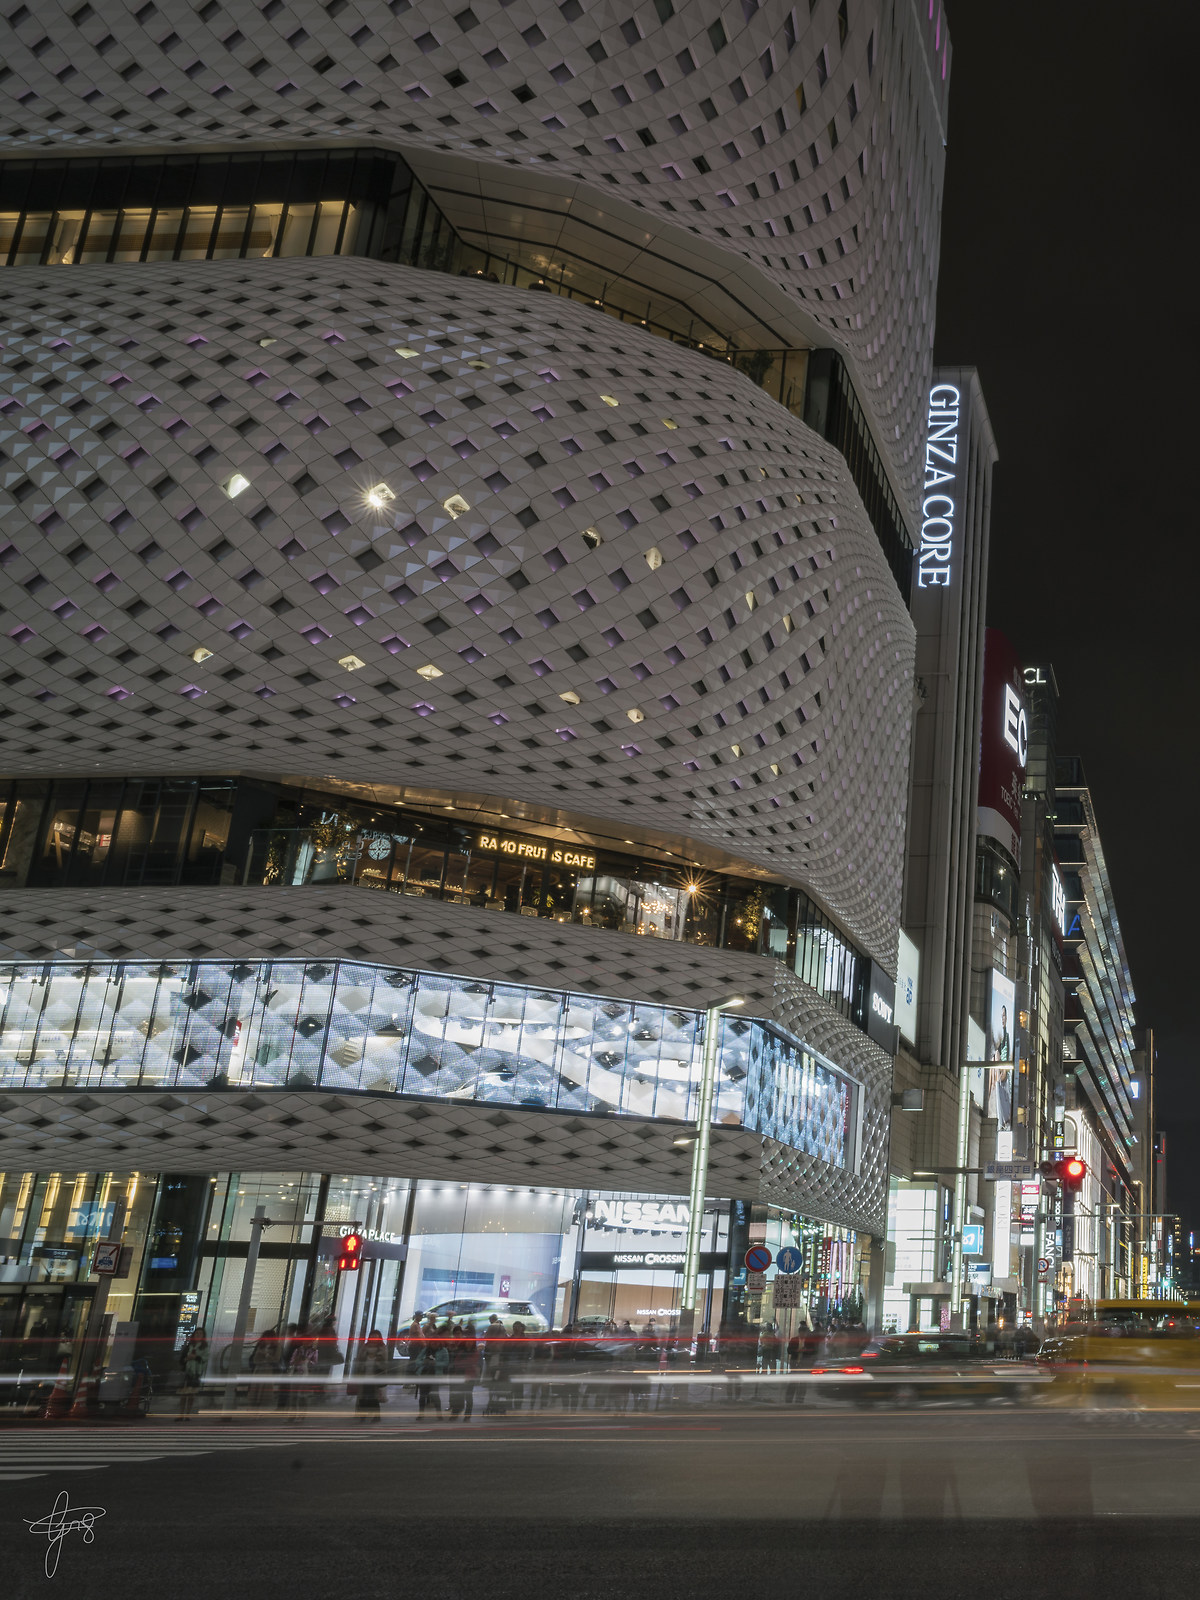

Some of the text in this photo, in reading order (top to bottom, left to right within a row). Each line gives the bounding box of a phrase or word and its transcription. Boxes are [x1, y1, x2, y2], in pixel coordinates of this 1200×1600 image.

[918, 384, 960, 588] GINZA CORE
[518, 844, 562, 862] FRUTS
[564, 852, 594, 869] CAFE
[872, 992, 893, 1023] SONY
[987, 1165, 1031, 1174] 銀座四丁目
[594, 1200, 690, 1222] NISSAN
[368, 1229, 395, 1241] PLACE
[614, 1253, 686, 1264] NISSAN CROSSIN
